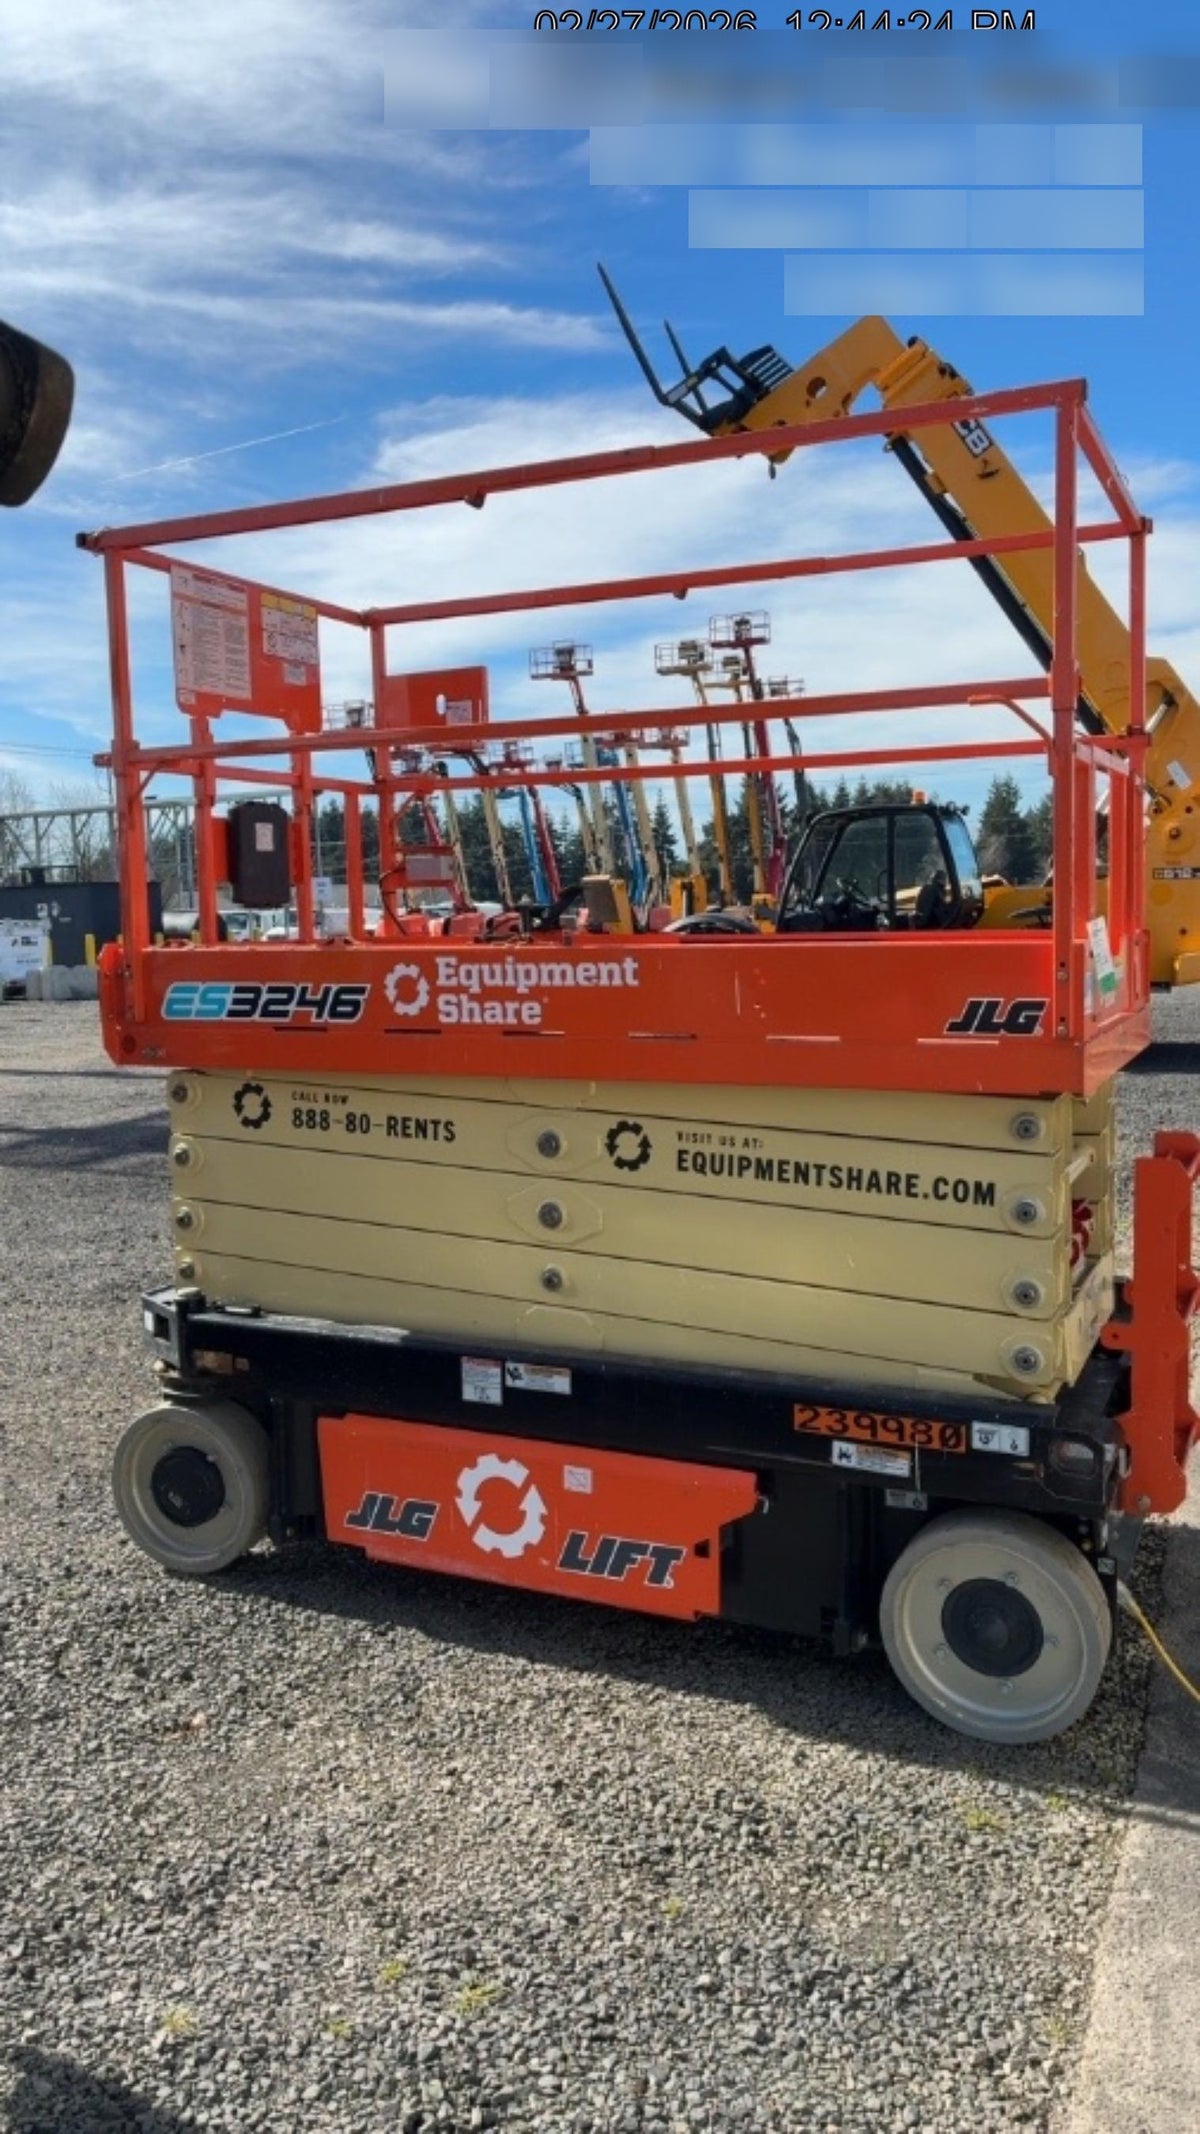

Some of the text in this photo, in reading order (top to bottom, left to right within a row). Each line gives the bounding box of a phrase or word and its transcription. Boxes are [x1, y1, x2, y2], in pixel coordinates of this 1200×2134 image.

[435, 956, 639, 991] Equipment
[161, 982, 370, 1021] ES3246
[437, 993, 542, 1024] Share
[946, 998, 1049, 1035] JLG
[291, 1091, 349, 1105] CALL NOW
[291, 1107, 457, 1143] 888-80-RENTS
[677, 1131, 712, 1144] VISIT
[719, 1135, 736, 1148] US
[677, 1149, 996, 1207] EQUIPMENTSHARE.COM
[798, 1406, 963, 1450] 239980
[345, 1492, 439, 1541] JLG
[556, 1531, 686, 1588] LIFT
